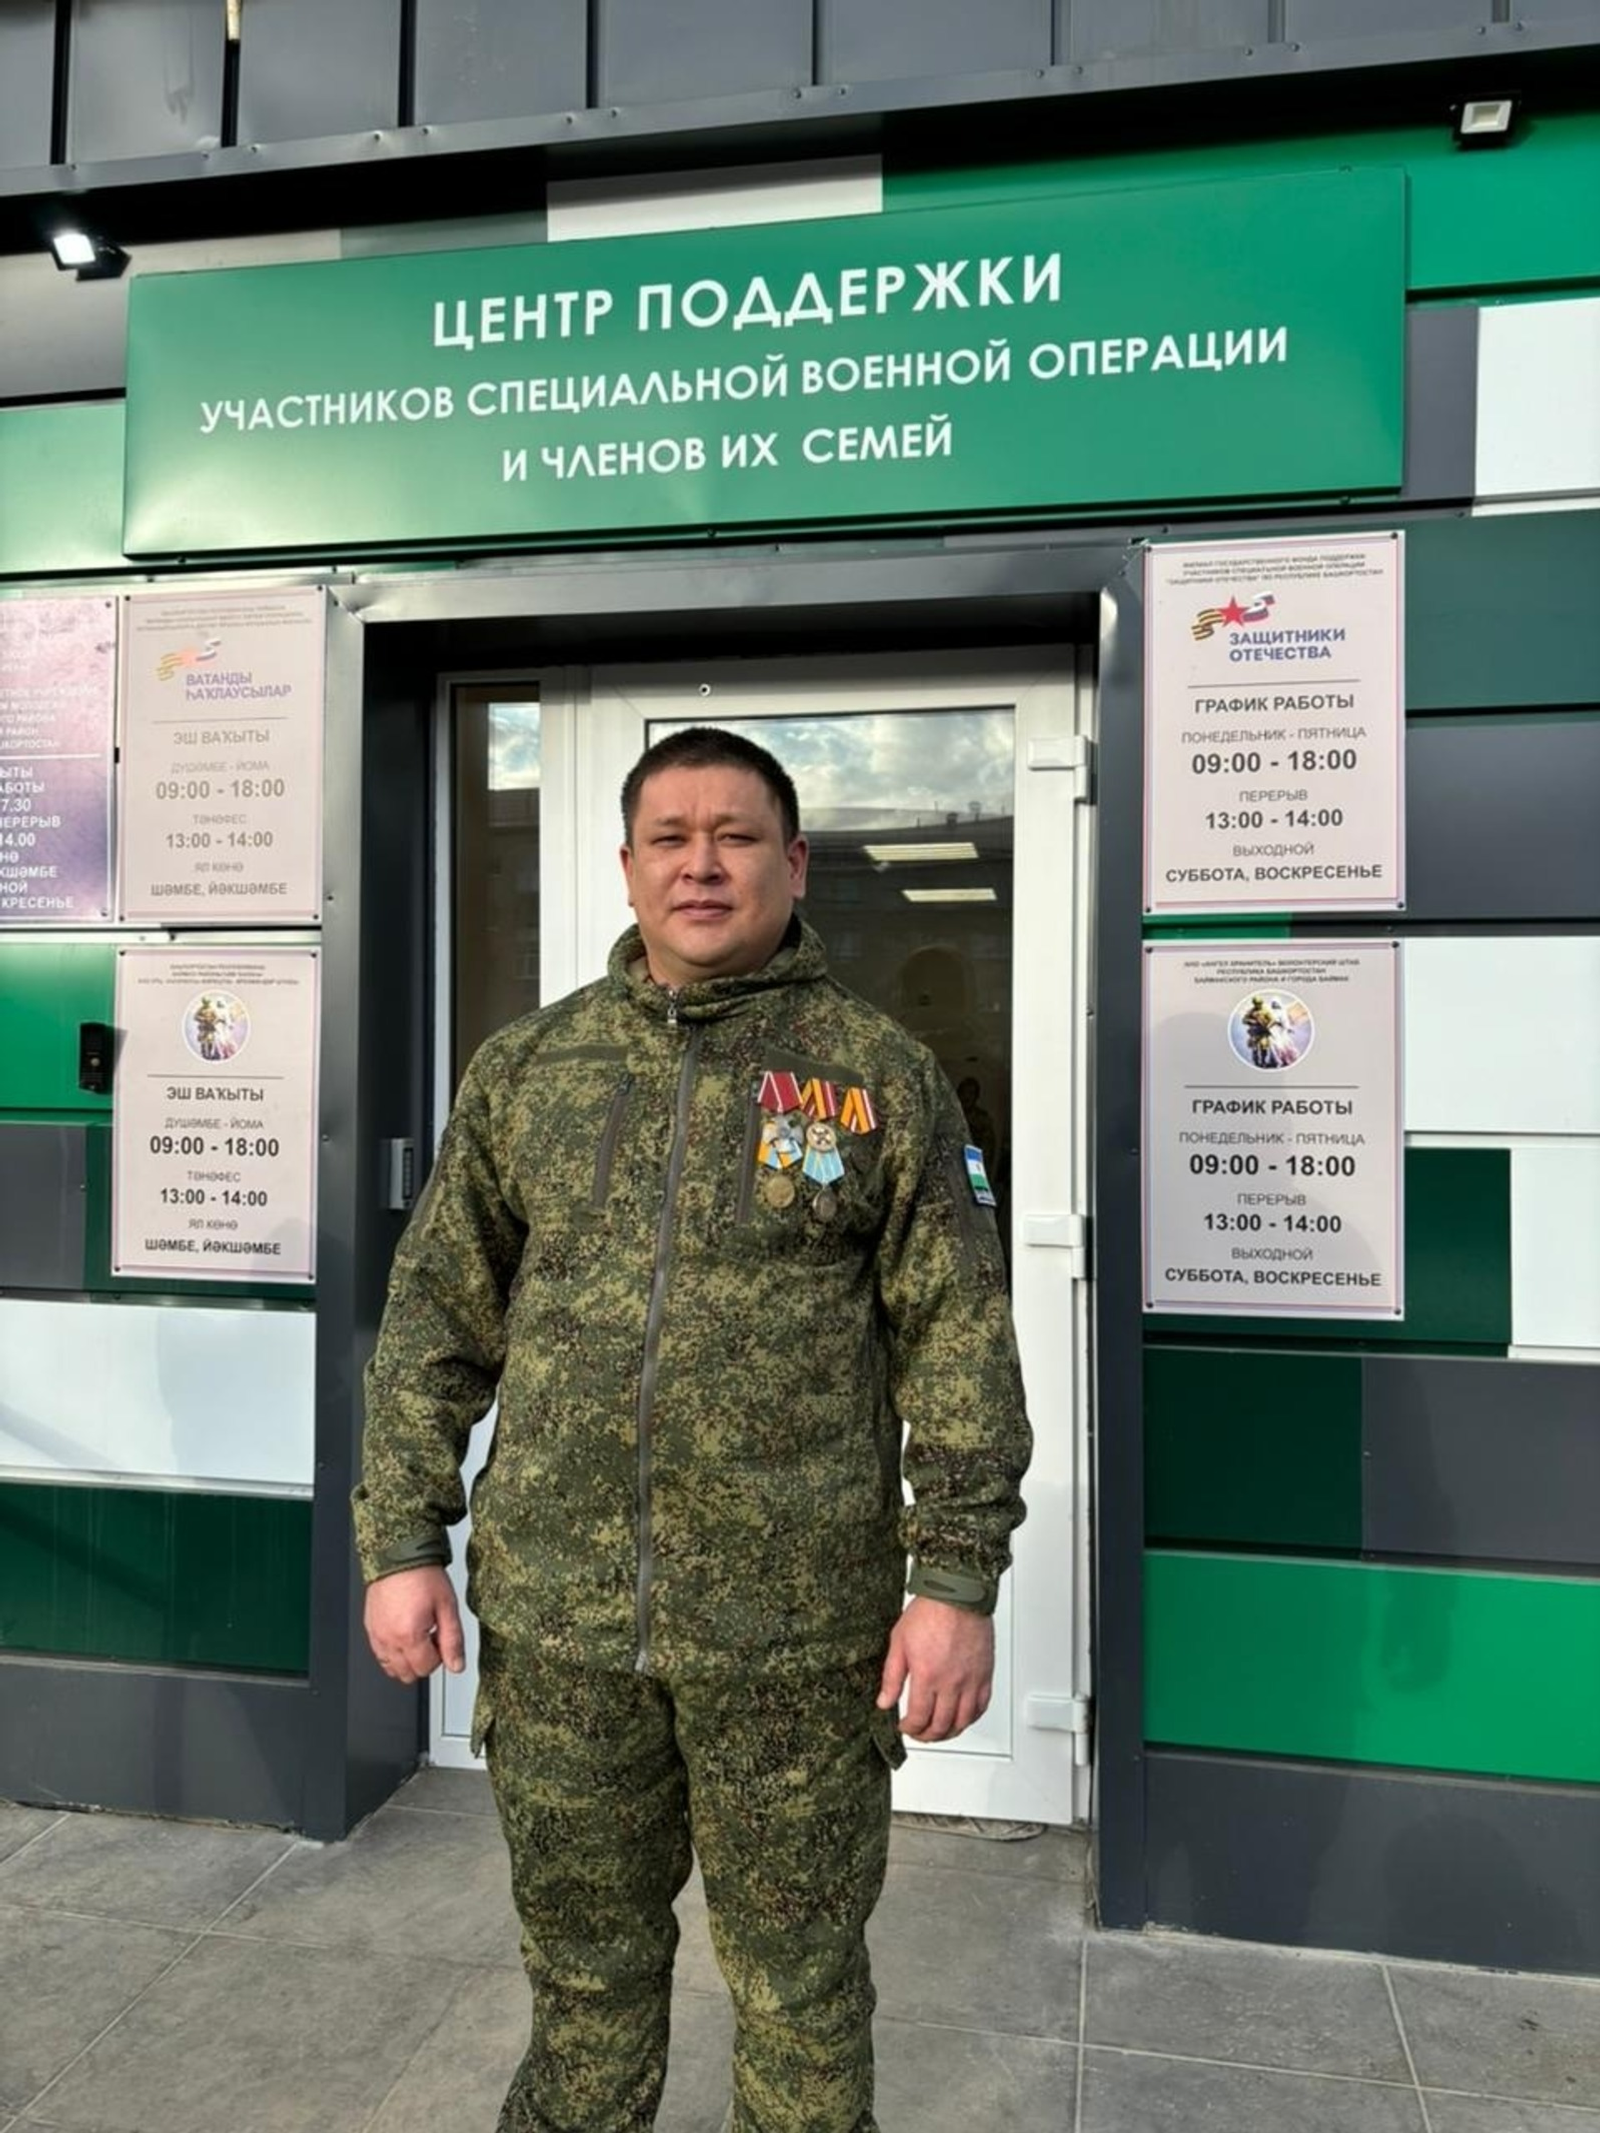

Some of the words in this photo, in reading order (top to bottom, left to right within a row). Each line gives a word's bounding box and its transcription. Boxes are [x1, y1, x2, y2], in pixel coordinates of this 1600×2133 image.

[434, 290, 612, 351] ЦЕНТР
[639, 253, 1060, 331] ПОДДЕРЖКИ
[200, 387, 453, 434] УЧАСТНИКОВ
[467, 354, 787, 416] СПЕЦИАЛЬНОЙ
[803, 339, 1010, 394] ВОЕННОЙ
[1029, 327, 1286, 379] ОПЕРАЦИИ
[504, 449, 526, 481] И
[542, 438, 706, 478] ЧЛЕНОВ
[722, 433, 778, 468] ИХ
[803, 414, 951, 463] СЕМЕЙ
[1230, 629, 1345, 645] ЗАЩИТНИКИ
[1229, 646, 1331, 662] ОТЕЧЕСТВА
[186, 672, 252, 686] ВАТАНДЫ
[1195, 697, 1268, 713] ГРАФИК
[1274, 694, 1353, 710] РАБОТЫ
[174, 731, 197, 745] ЭШ
[201, 729, 269, 744] ВАҠЫТЫ
[1182, 729, 1286, 744] ПОНЕДЕЛЬНИК
[1298, 727, 1366, 739] ПЯТНИЦА
[1192, 752, 1261, 774] 09:00
[1288, 749, 1356, 770] 18:00
[156, 781, 210, 799] 09:00
[231, 779, 285, 797] 18:00
[1239, 789, 1308, 802] ПЕРЕРЫВ
[1206, 811, 1263, 829] 13:00
[1286, 809, 1343, 827] 14:00
[166, 833, 211, 848] 13:00
[228, 831, 273, 847] 14:00
[1233, 841, 1314, 857] ВЫХОДНОЙ
[1166, 868, 1249, 882] СУББОТА,
[1255, 865, 1381, 880] ВОСКРЕСЕНЬЕ
[167, 1087, 191, 1100] ЭШ
[196, 1087, 263, 1101] ВАҠЫТЫ
[1193, 1100, 1265, 1114] ГРАФИК
[1272, 1100, 1352, 1115] РАБОТЫ
[230, 1117, 264, 1129] ЙОМА
[150, 1136, 204, 1155] 09:00
[225, 1138, 279, 1157] 18:00
[1179, 1132, 1284, 1145] ПОНЕДЕЛЬНИК
[1296, 1133, 1365, 1146] ПЯТНИЦА
[1190, 1154, 1258, 1175] 09:00
[1286, 1155, 1355, 1176] 18:00
[161, 1188, 205, 1204] 13:00
[222, 1190, 267, 1206] 14:00
[1237, 1193, 1306, 1206] ПЕРЕРЫВ
[1205, 1214, 1261, 1231] 13:00
[1284, 1215, 1341, 1233] 14:00
[145, 1239, 199, 1252] ШӘМБЕ,
[203, 1241, 281, 1255] ЙӘКШӘМБЕ
[1231, 1247, 1313, 1261] ВЫХОДНОЙ
[1165, 1268, 1248, 1284] СУББОТА,
[1254, 1271, 1380, 1286] ВОСКРЕСЕНЬЕ
